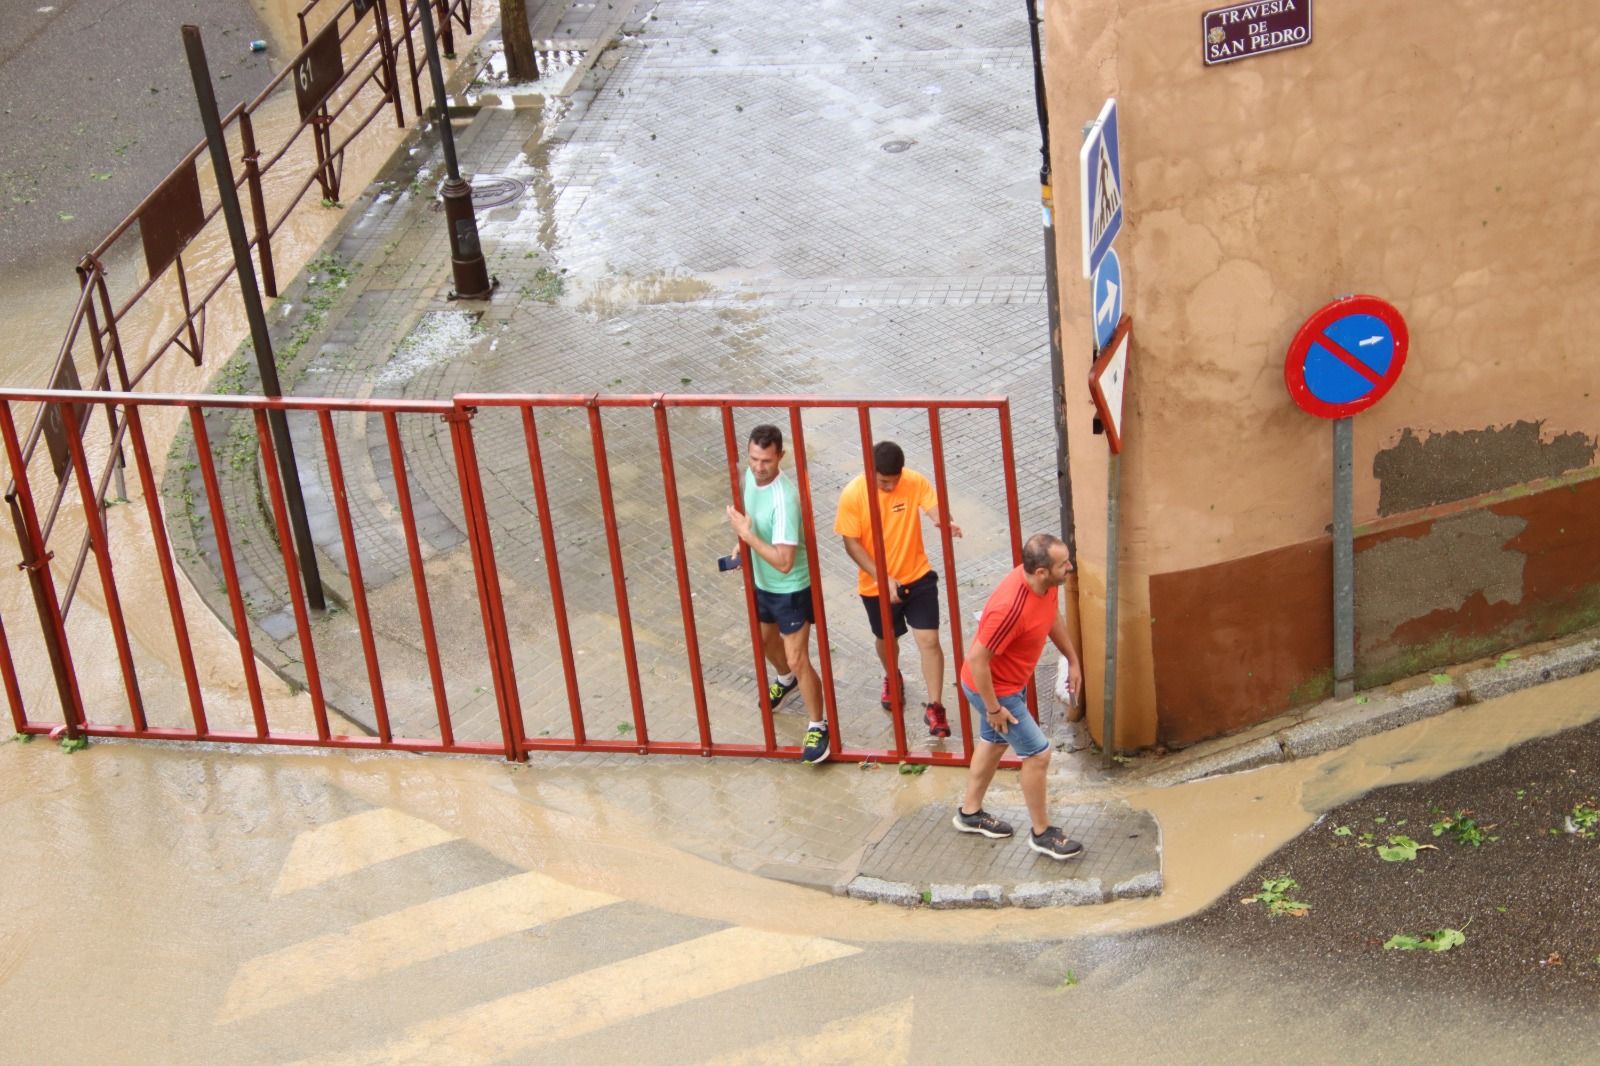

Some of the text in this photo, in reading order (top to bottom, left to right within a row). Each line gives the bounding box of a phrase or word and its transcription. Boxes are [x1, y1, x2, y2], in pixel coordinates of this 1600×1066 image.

[1211, 26, 1306, 58] SAN PEDRO
[1248, 21, 1268, 35] DE
[300, 57, 313, 91] 61
